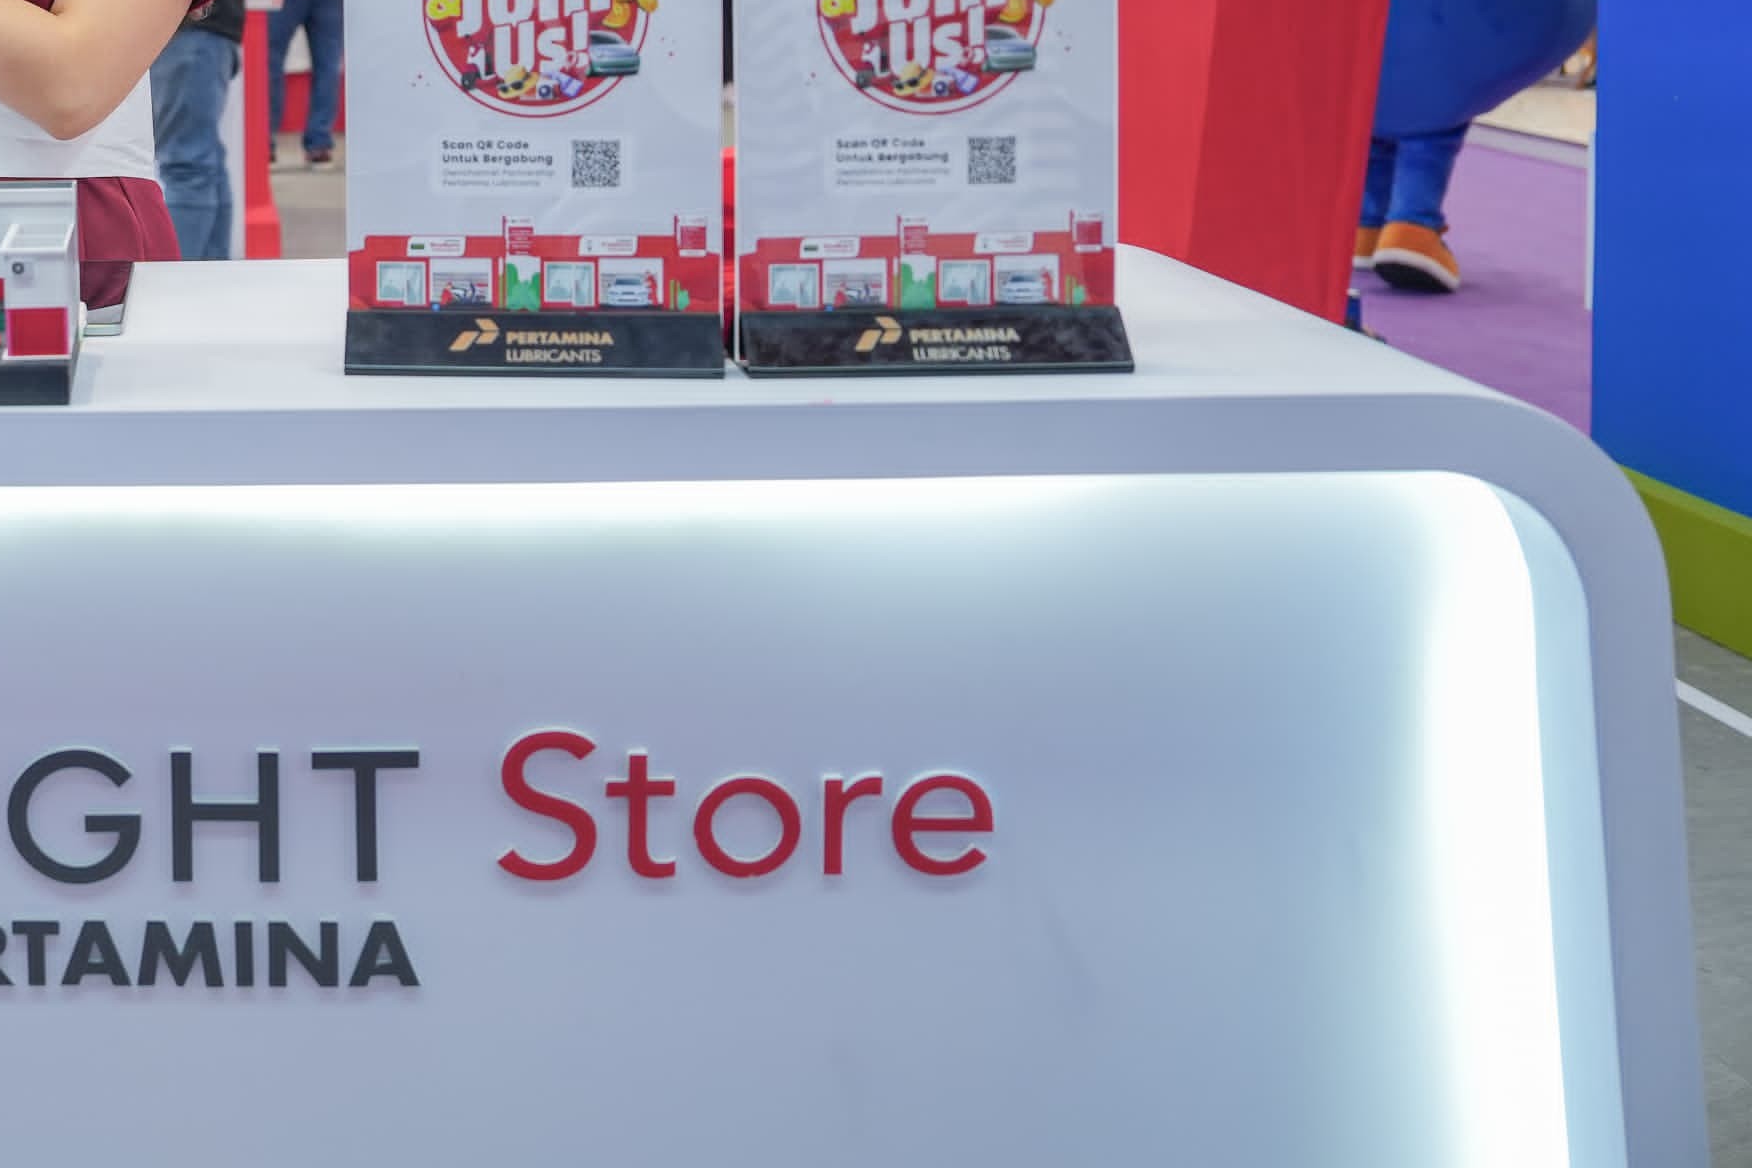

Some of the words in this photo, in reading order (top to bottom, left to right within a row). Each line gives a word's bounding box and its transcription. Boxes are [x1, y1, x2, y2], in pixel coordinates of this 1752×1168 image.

[441, 139, 473, 150] Scan
[476, 139, 493, 151] QR
[496, 139, 529, 150] Code
[441, 153, 479, 163] Untuk
[483, 153, 553, 167] Bergabung
[505, 331, 614, 346] PERTAMINA
[909, 327, 1021, 343] PERTAMINA
[505, 348, 602, 363] LUBRICANTS
[912, 346, 1012, 361] LUBRICANTS
[496, 727, 995, 882] Store
